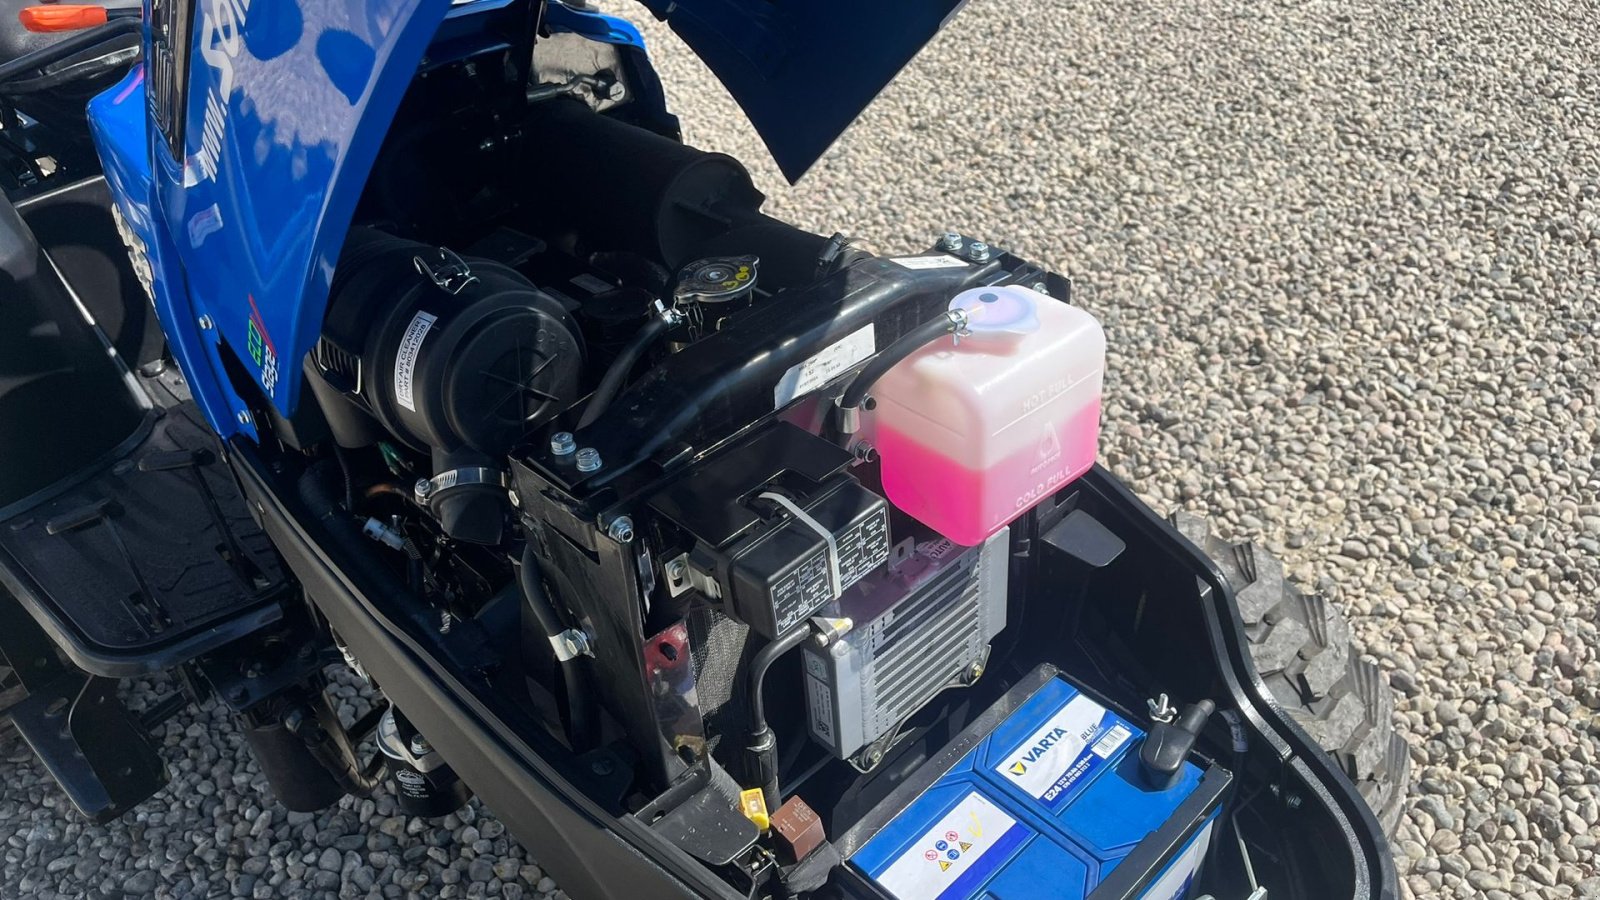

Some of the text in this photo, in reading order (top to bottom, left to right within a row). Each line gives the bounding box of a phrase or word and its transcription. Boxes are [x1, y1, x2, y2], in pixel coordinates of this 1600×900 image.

[247, 318, 262, 368] ECO
[400, 320, 421, 360] CLEANER
[261, 345, 279, 399] Stage
[1048, 373, 1074, 396] FULL
[1015, 465, 1072, 508] COLD FULL
[1022, 726, 1068, 763] VARTA
[1080, 723, 1098, 741] BLUE
[1043, 784, 1063, 802] E24
